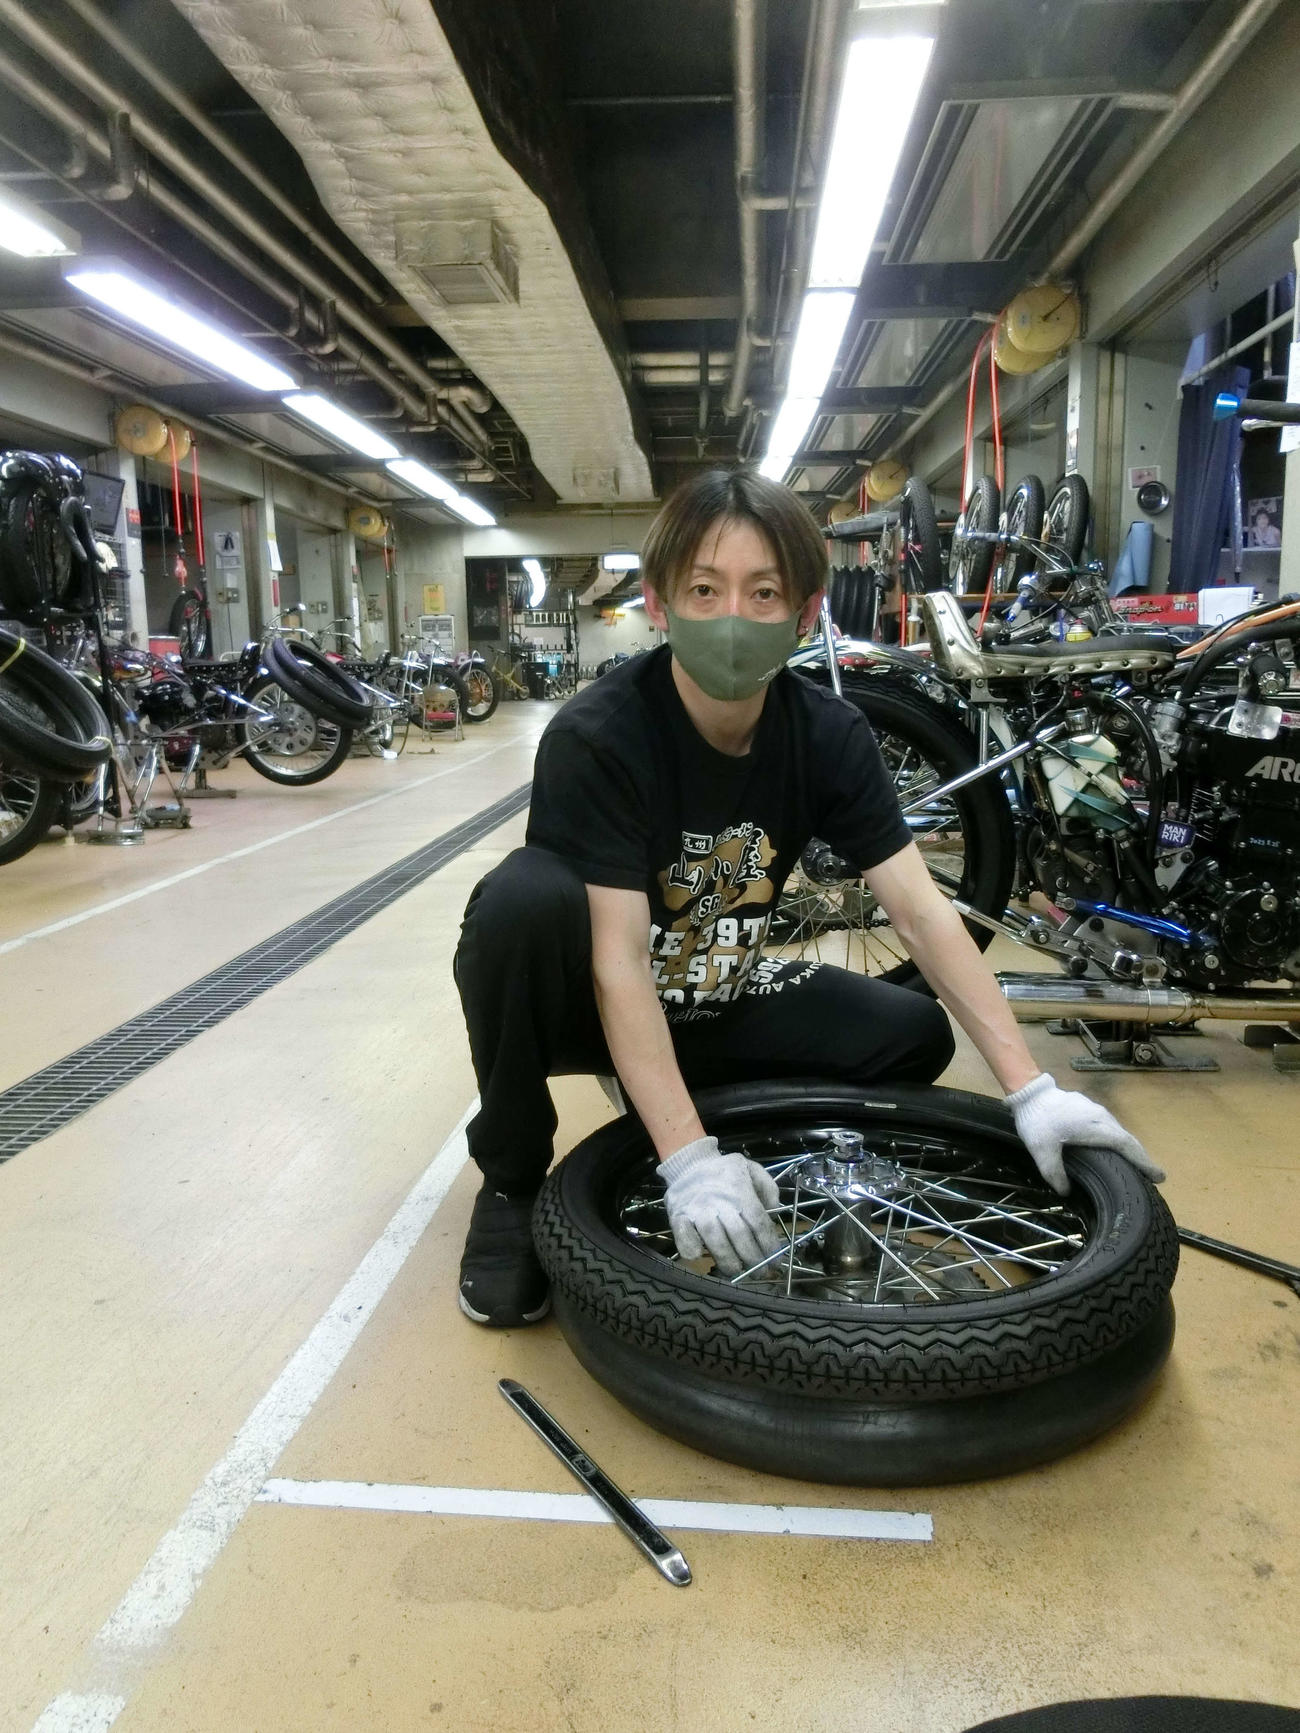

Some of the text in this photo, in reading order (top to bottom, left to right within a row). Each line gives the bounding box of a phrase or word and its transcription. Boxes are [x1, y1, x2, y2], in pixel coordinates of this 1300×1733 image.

[1163, 824, 1187, 837] MAN
[684, 837, 706, 850] 九州
[1161, 832, 1185, 844] RIKI
